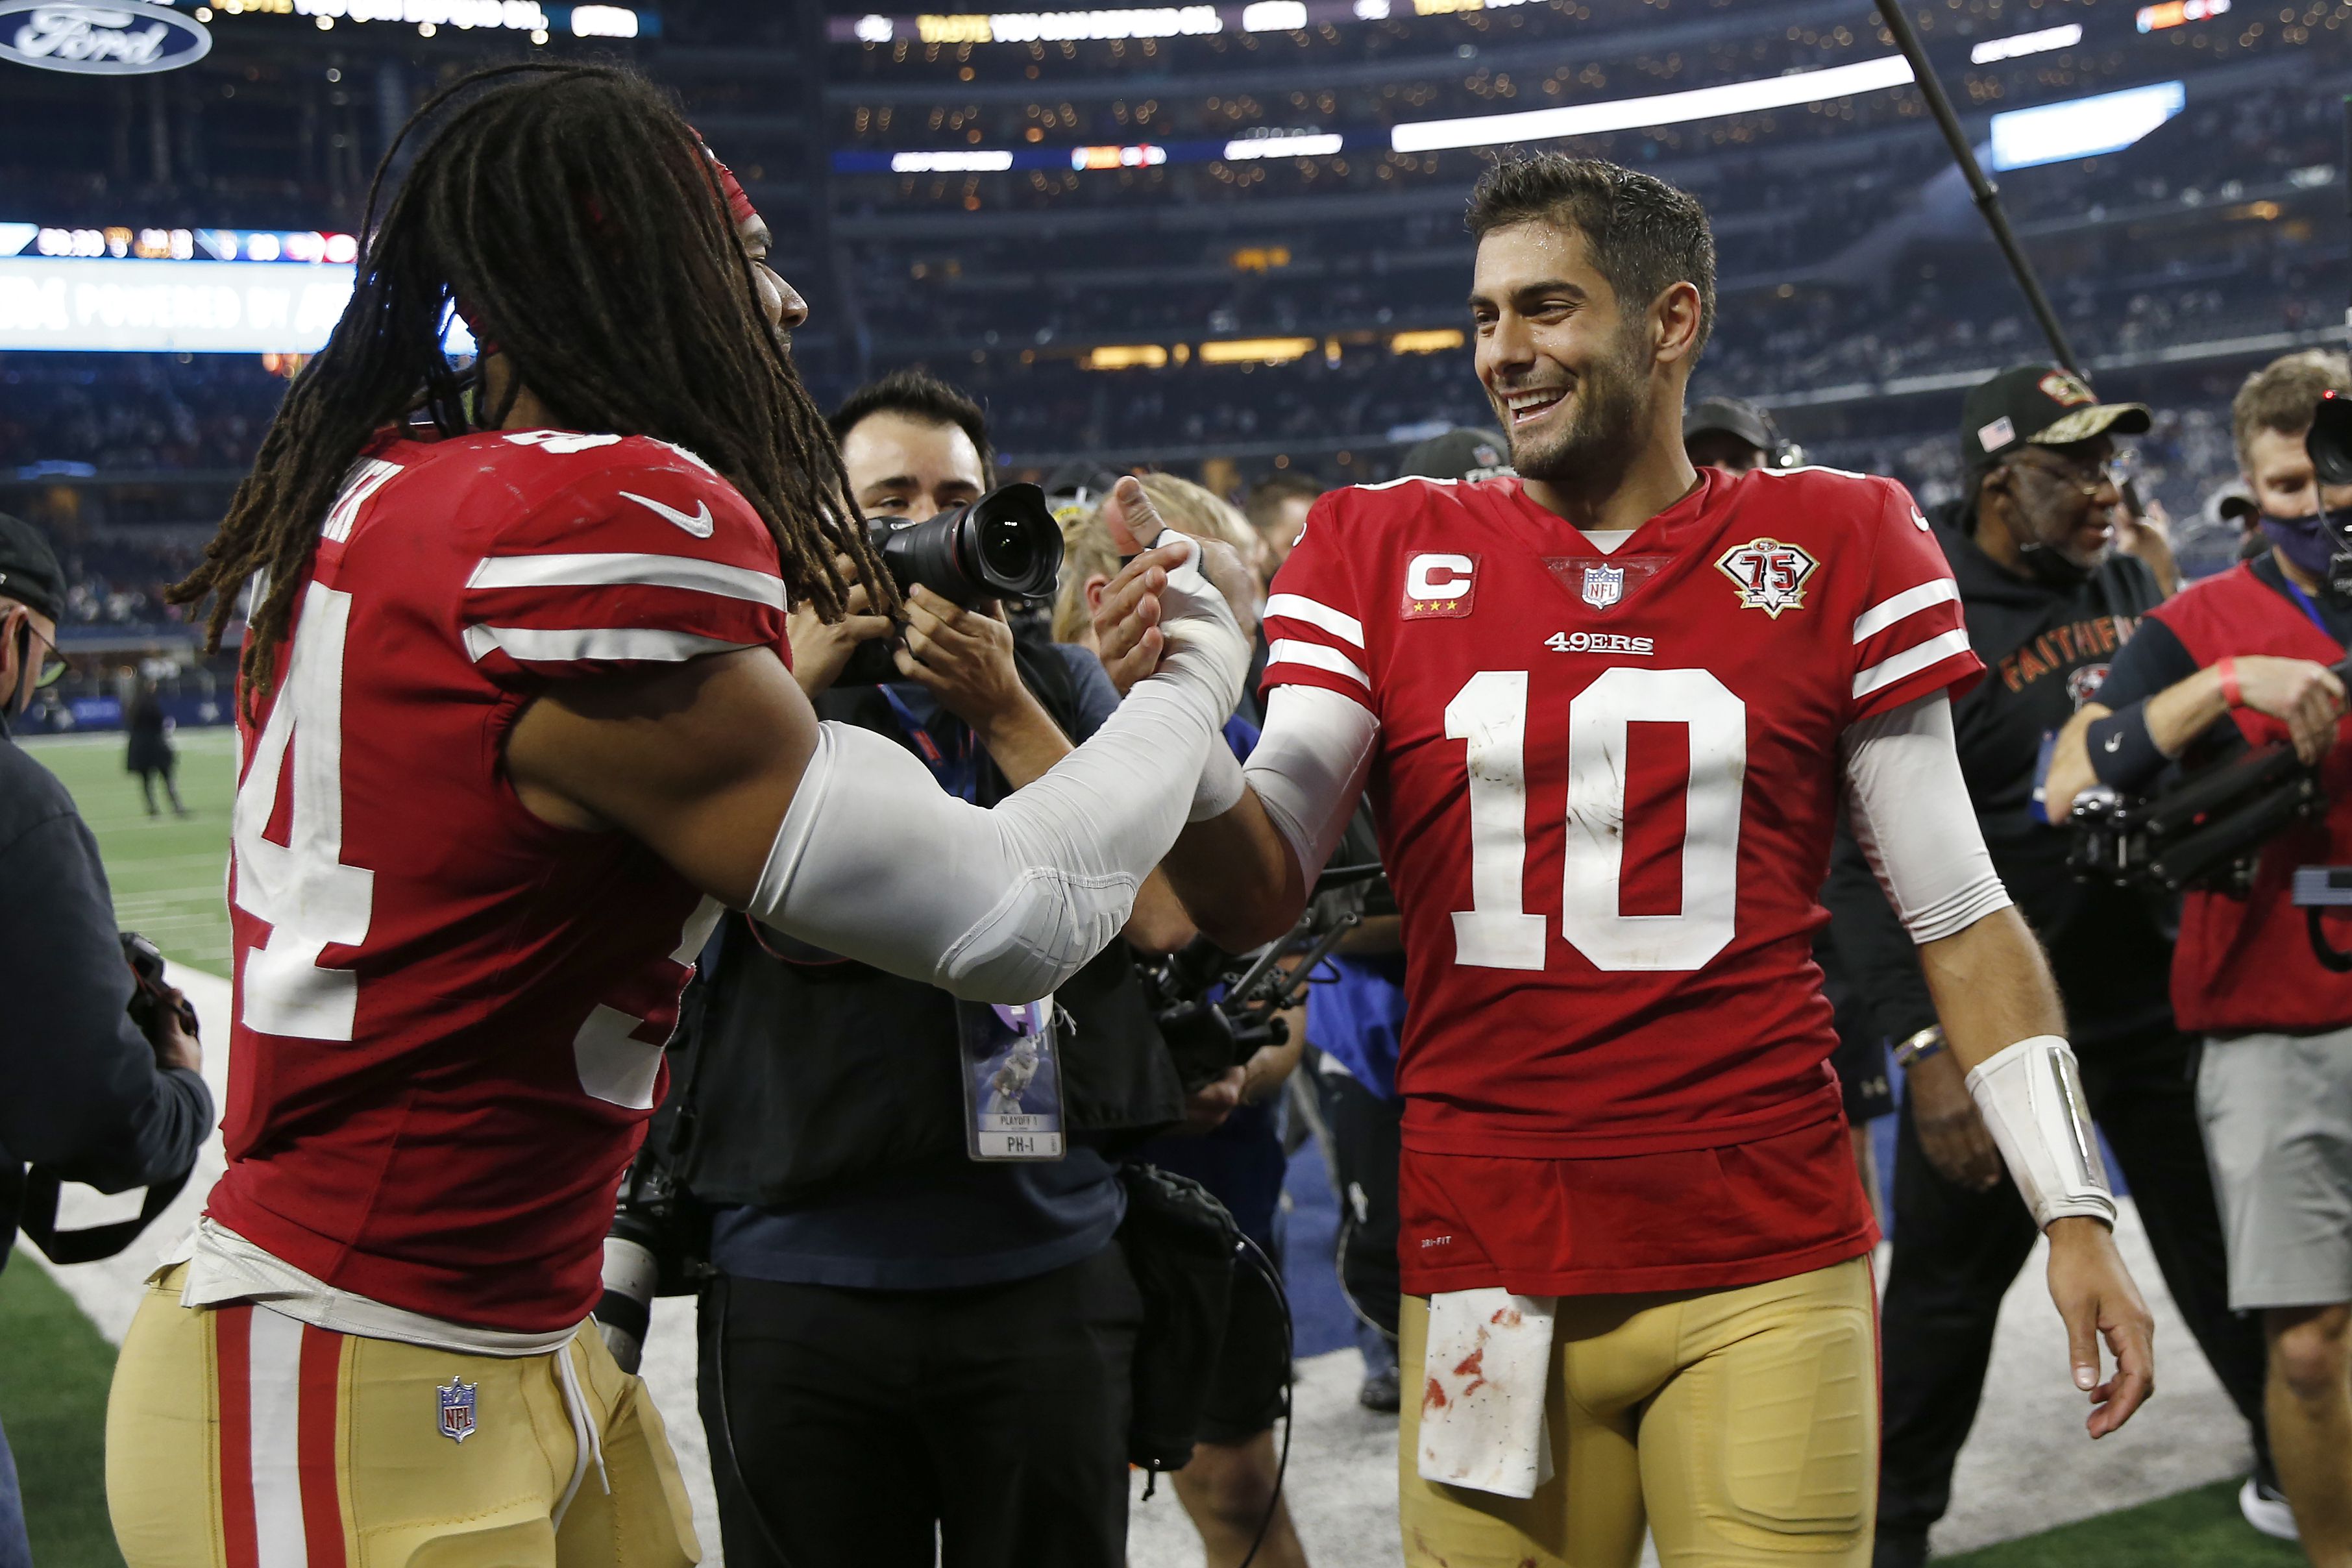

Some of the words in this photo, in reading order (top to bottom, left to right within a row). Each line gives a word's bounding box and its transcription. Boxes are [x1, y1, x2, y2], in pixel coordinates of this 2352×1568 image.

[14, 9, 169, 65] Ford
[1407, 554, 1473, 600] C
[1741, 554, 1798, 593] 75
[1590, 583, 1615, 599] NFL
[1544, 631, 1654, 655] 49ERS
[1443, 667, 1747, 972] 10
[1421, 1236, 1452, 1248] DRI-FIT
[445, 1407, 472, 1431] NFL
